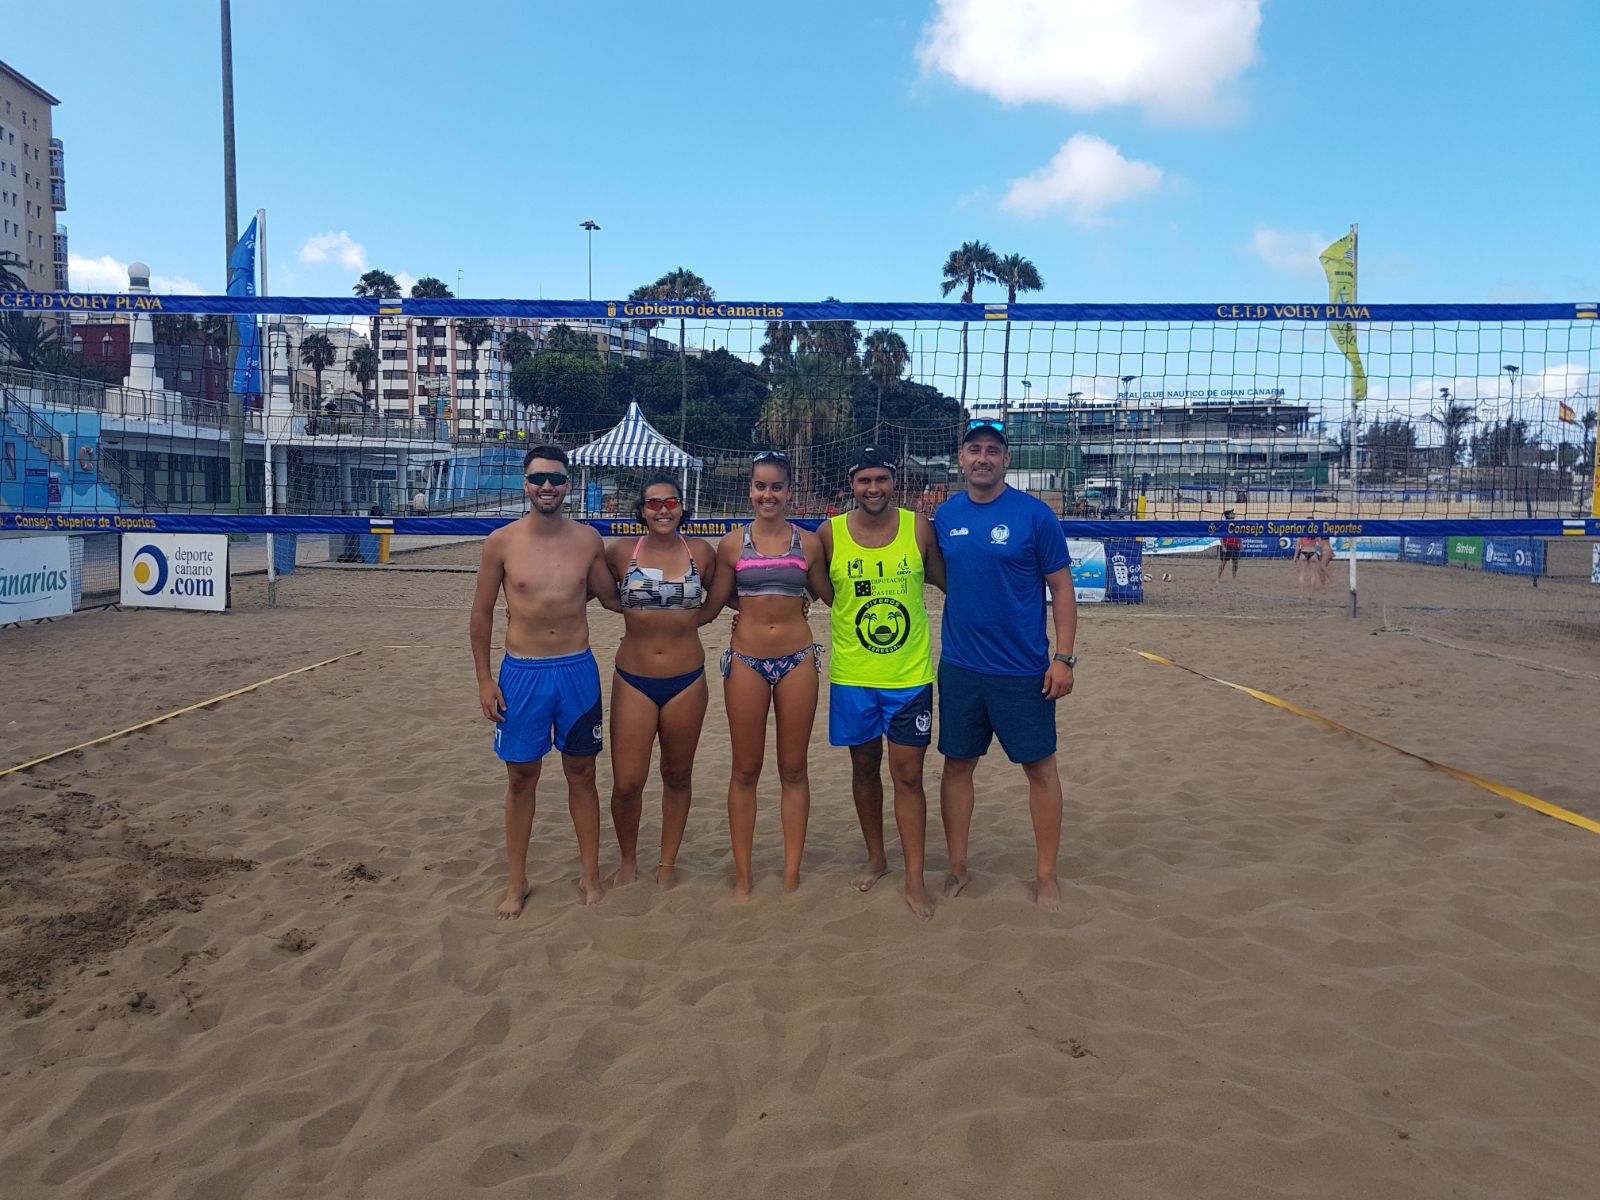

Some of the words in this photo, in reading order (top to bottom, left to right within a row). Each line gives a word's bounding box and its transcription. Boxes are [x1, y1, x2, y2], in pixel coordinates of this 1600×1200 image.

[1, 293, 54, 308] C.E.T.D
[59, 295, 110, 309] VOLEY
[116, 296, 163, 310] PLAYA
[624, 303, 695, 316] Gobierno
[697, 304, 714, 317] de
[717, 304, 784, 318] Canarias
[1217, 305, 1268, 318] C.E.T.D
[1273, 305, 1320, 318] VOLEY
[1326, 306, 1371, 319] PLAYA
[1142, 391, 1164, 399] CLUB
[1208, 389, 1218, 397] DE
[1220, 389, 1245, 397] GRAN
[15, 515, 53, 530] Consejo
[57, 516, 97, 530] Superior
[98, 516, 111, 527] de
[114, 516, 157, 529] Deportes
[680, 523, 727, 535] CANARIA
[1227, 522, 1264, 536] Consejo
[1267, 522, 1305, 536] Superior
[1308, 522, 1319, 533] de
[1322, 522, 1362, 535] Deportes
[175, 547, 214, 562] deporte
[175, 562, 212, 576] canario
[876, 561, 883, 577] 1
[0, 565, 68, 598] anarias
[170, 577, 214, 597] .com
[865, 598, 900, 608] VIVEROS
